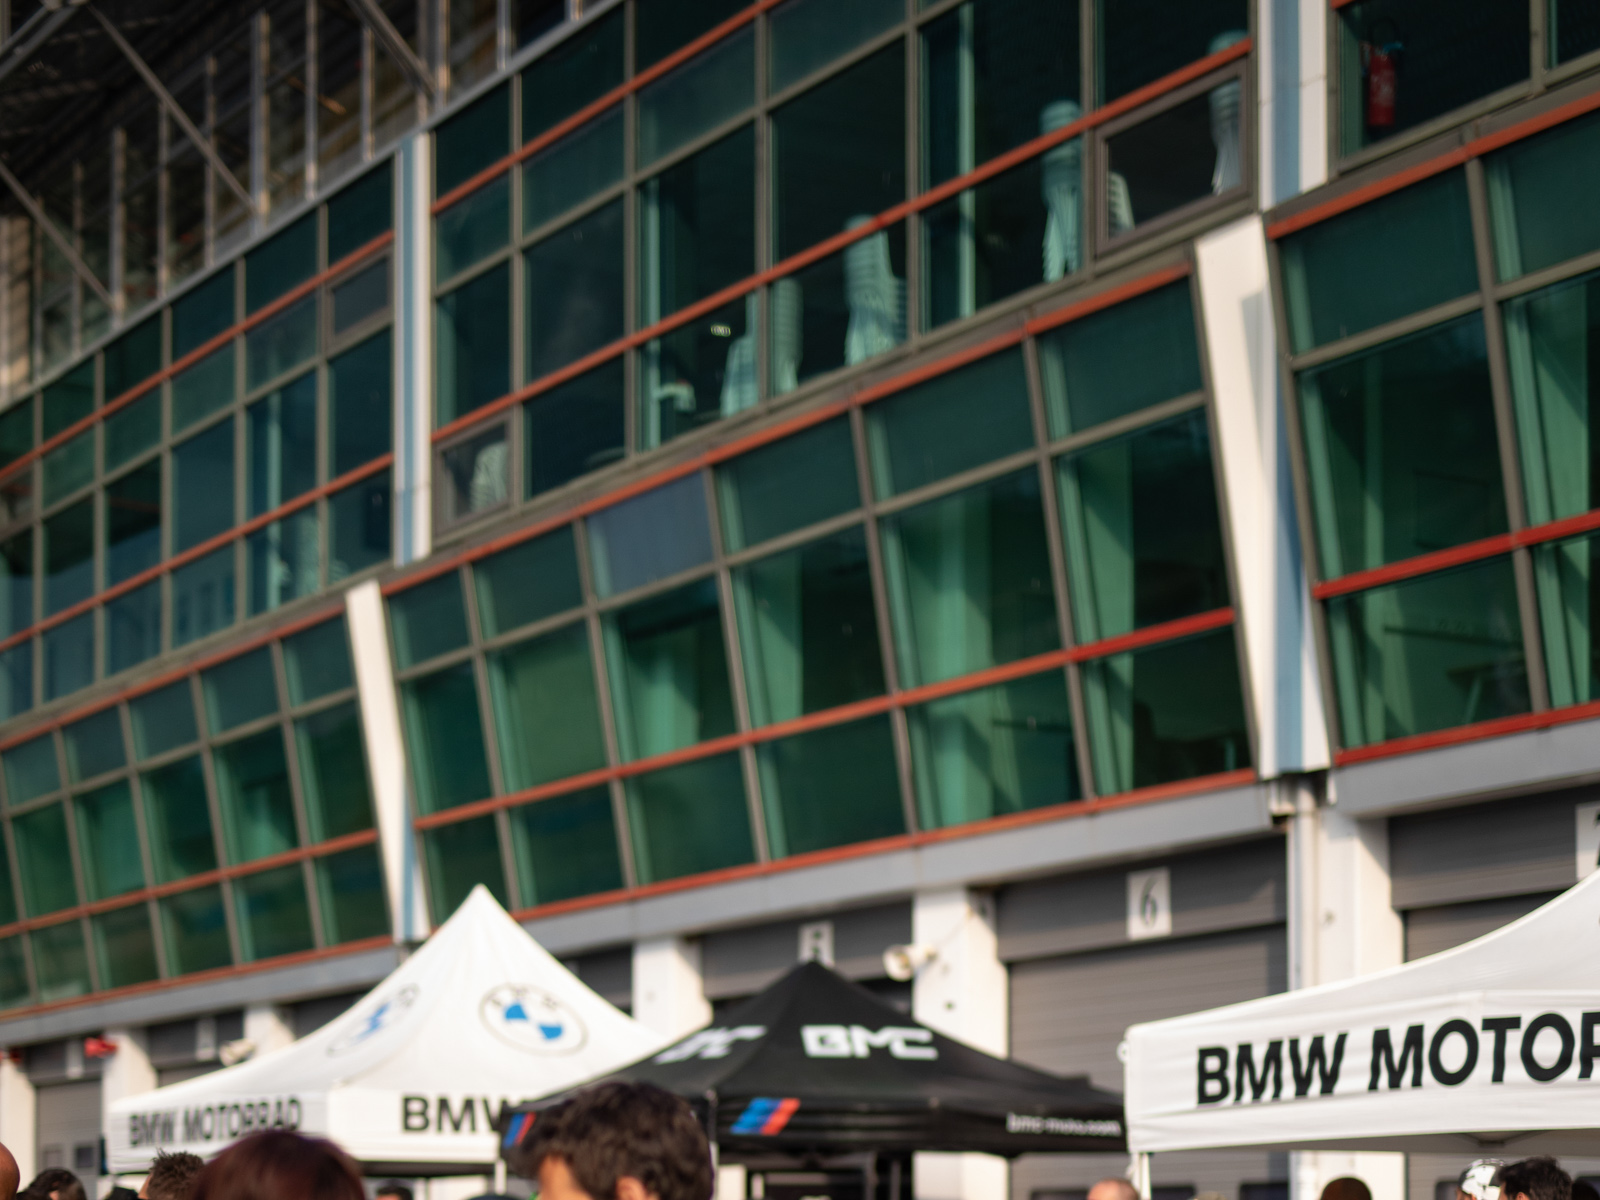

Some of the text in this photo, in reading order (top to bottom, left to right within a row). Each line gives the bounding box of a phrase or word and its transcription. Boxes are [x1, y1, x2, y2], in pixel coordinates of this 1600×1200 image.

[1139, 874, 1159, 930] 6
[1197, 1031, 1349, 1106] BMW
[129, 1095, 303, 1148] BMW MOTORRAD
